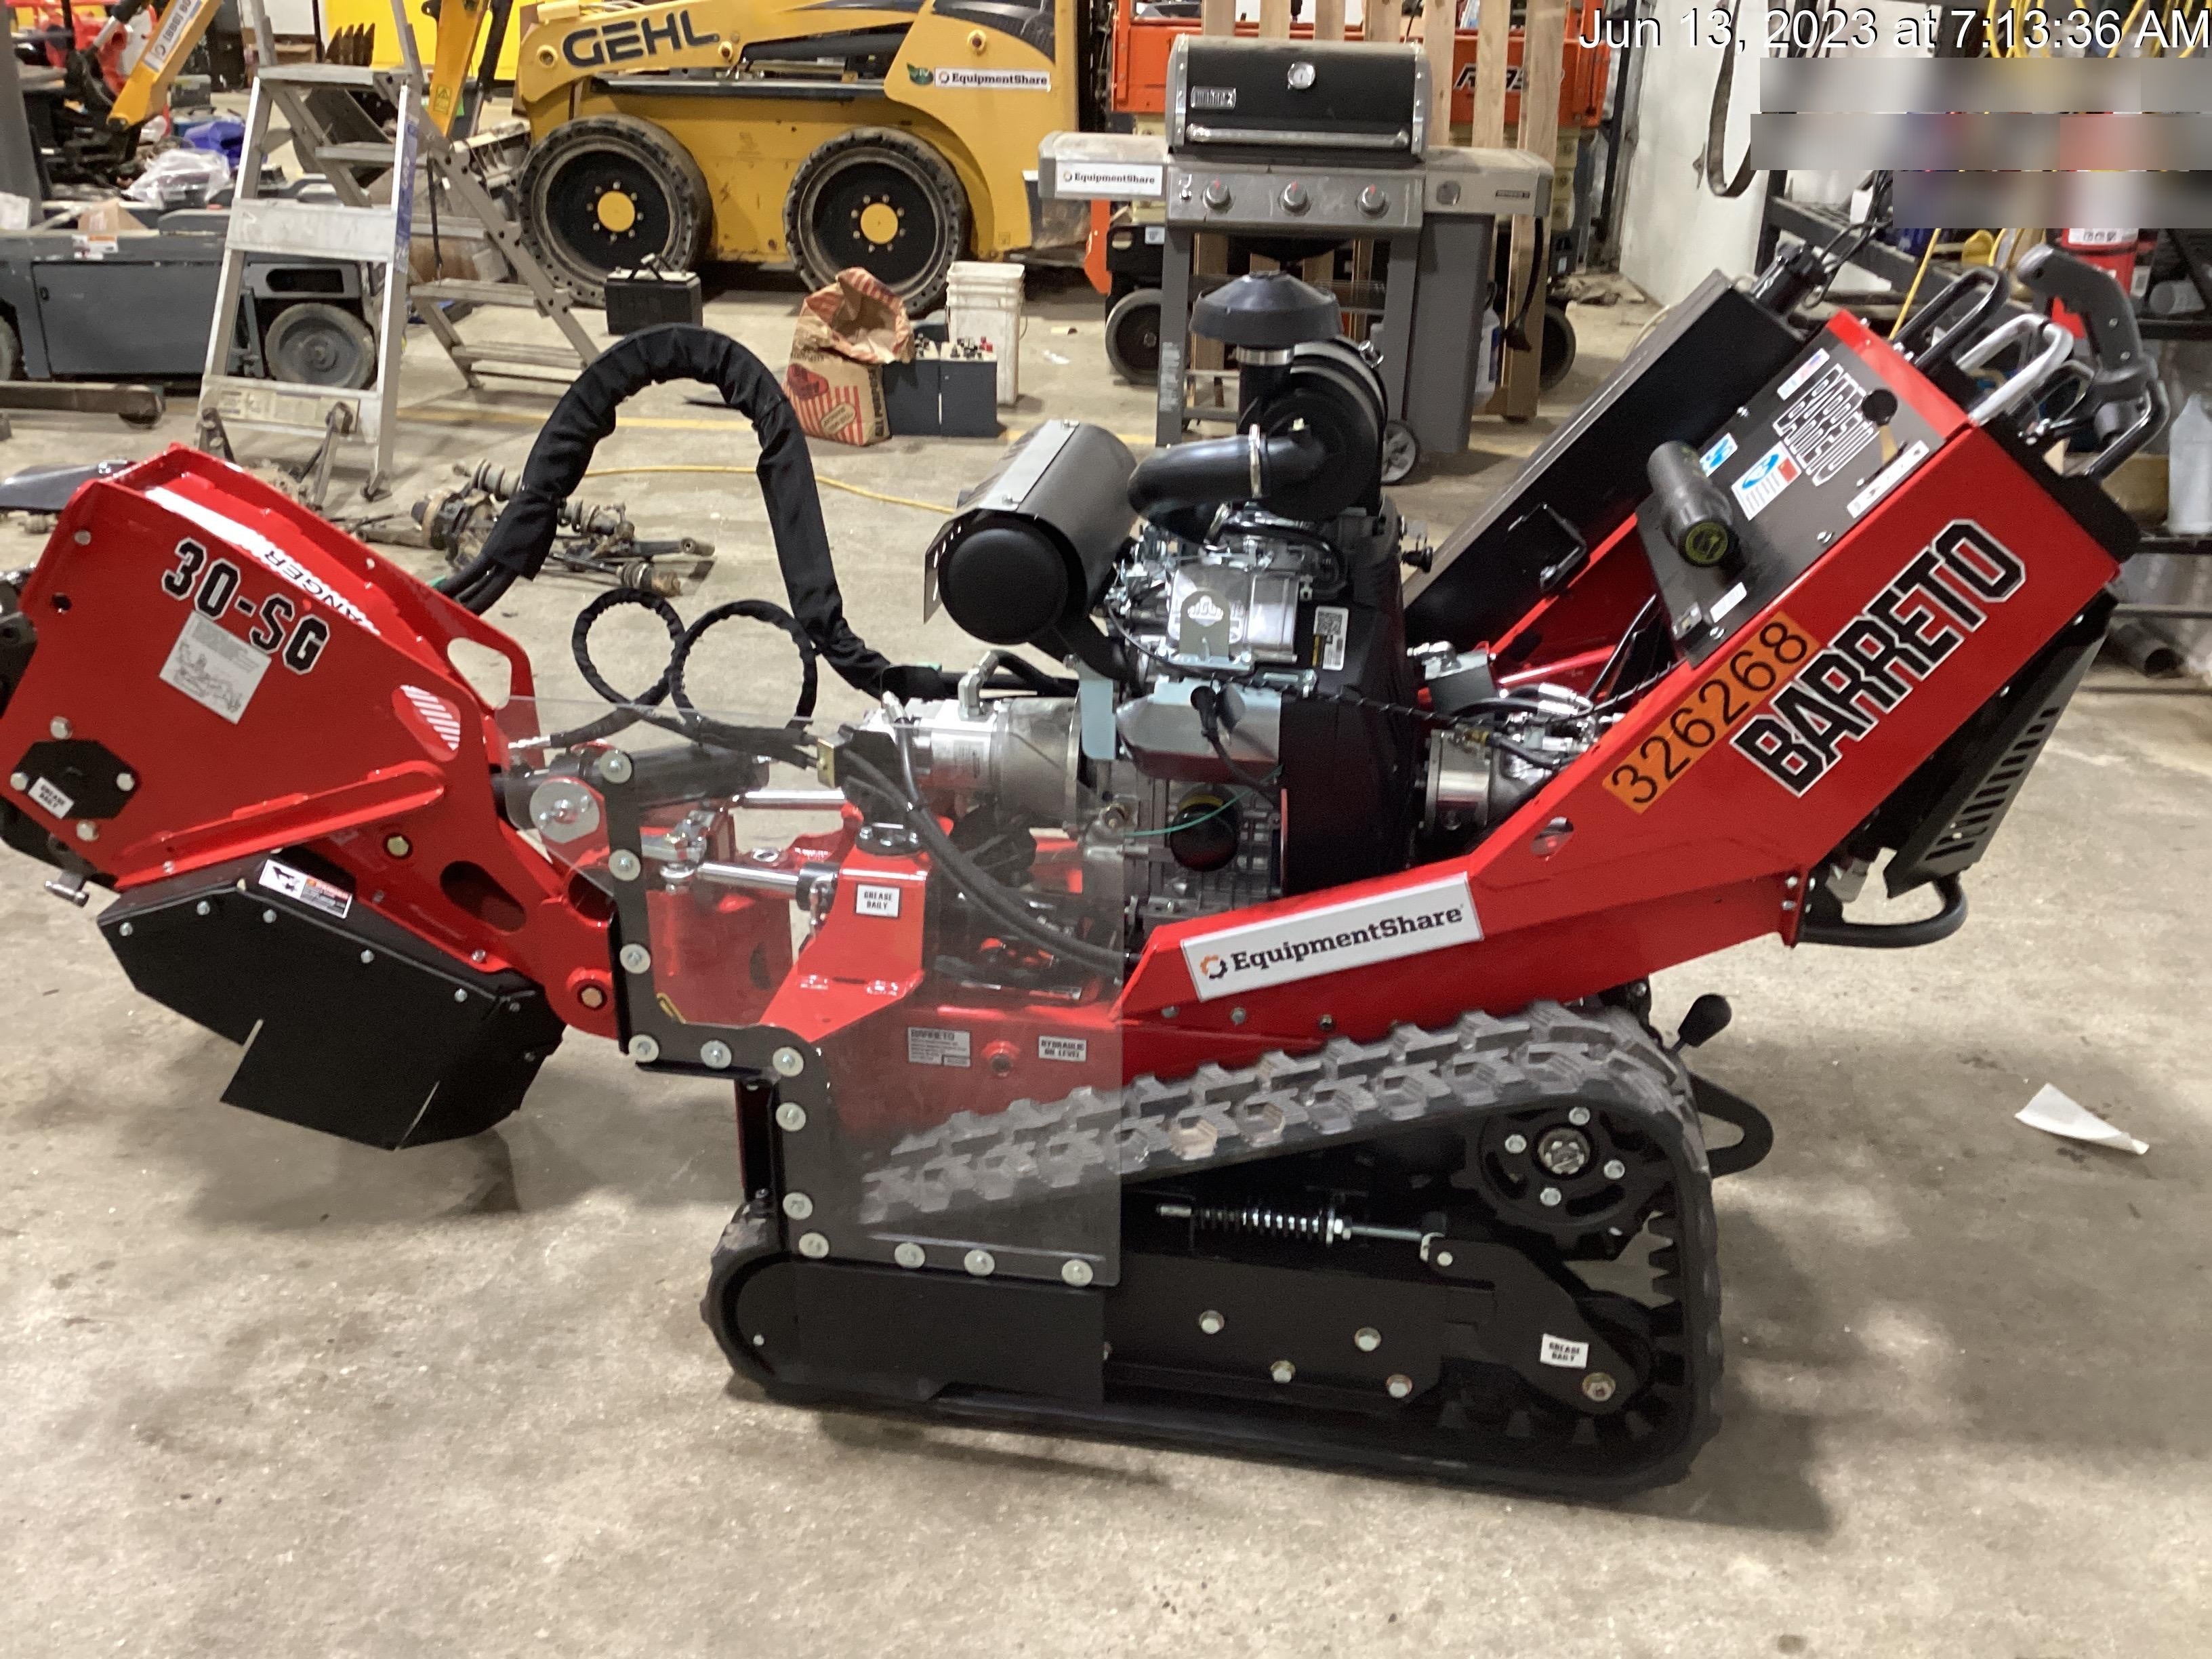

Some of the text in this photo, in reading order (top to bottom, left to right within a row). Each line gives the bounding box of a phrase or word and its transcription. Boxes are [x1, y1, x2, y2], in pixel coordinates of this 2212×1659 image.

[563, 9, 720, 67] GEHL
[951, 72, 1048, 86] EquipmentShare
[1074, 172, 1155, 184] EquipmentShare
[161, 537, 331, 676] 30-SG
[264, 550, 364, 623] ANGER
[1728, 518, 2026, 798] BARRETO
[1611, 621, 1808, 805] 326268
[864, 890, 893, 901] GREASE
[867, 901, 888, 910] DAILY
[1230, 906, 1463, 971] EquipmentShare
